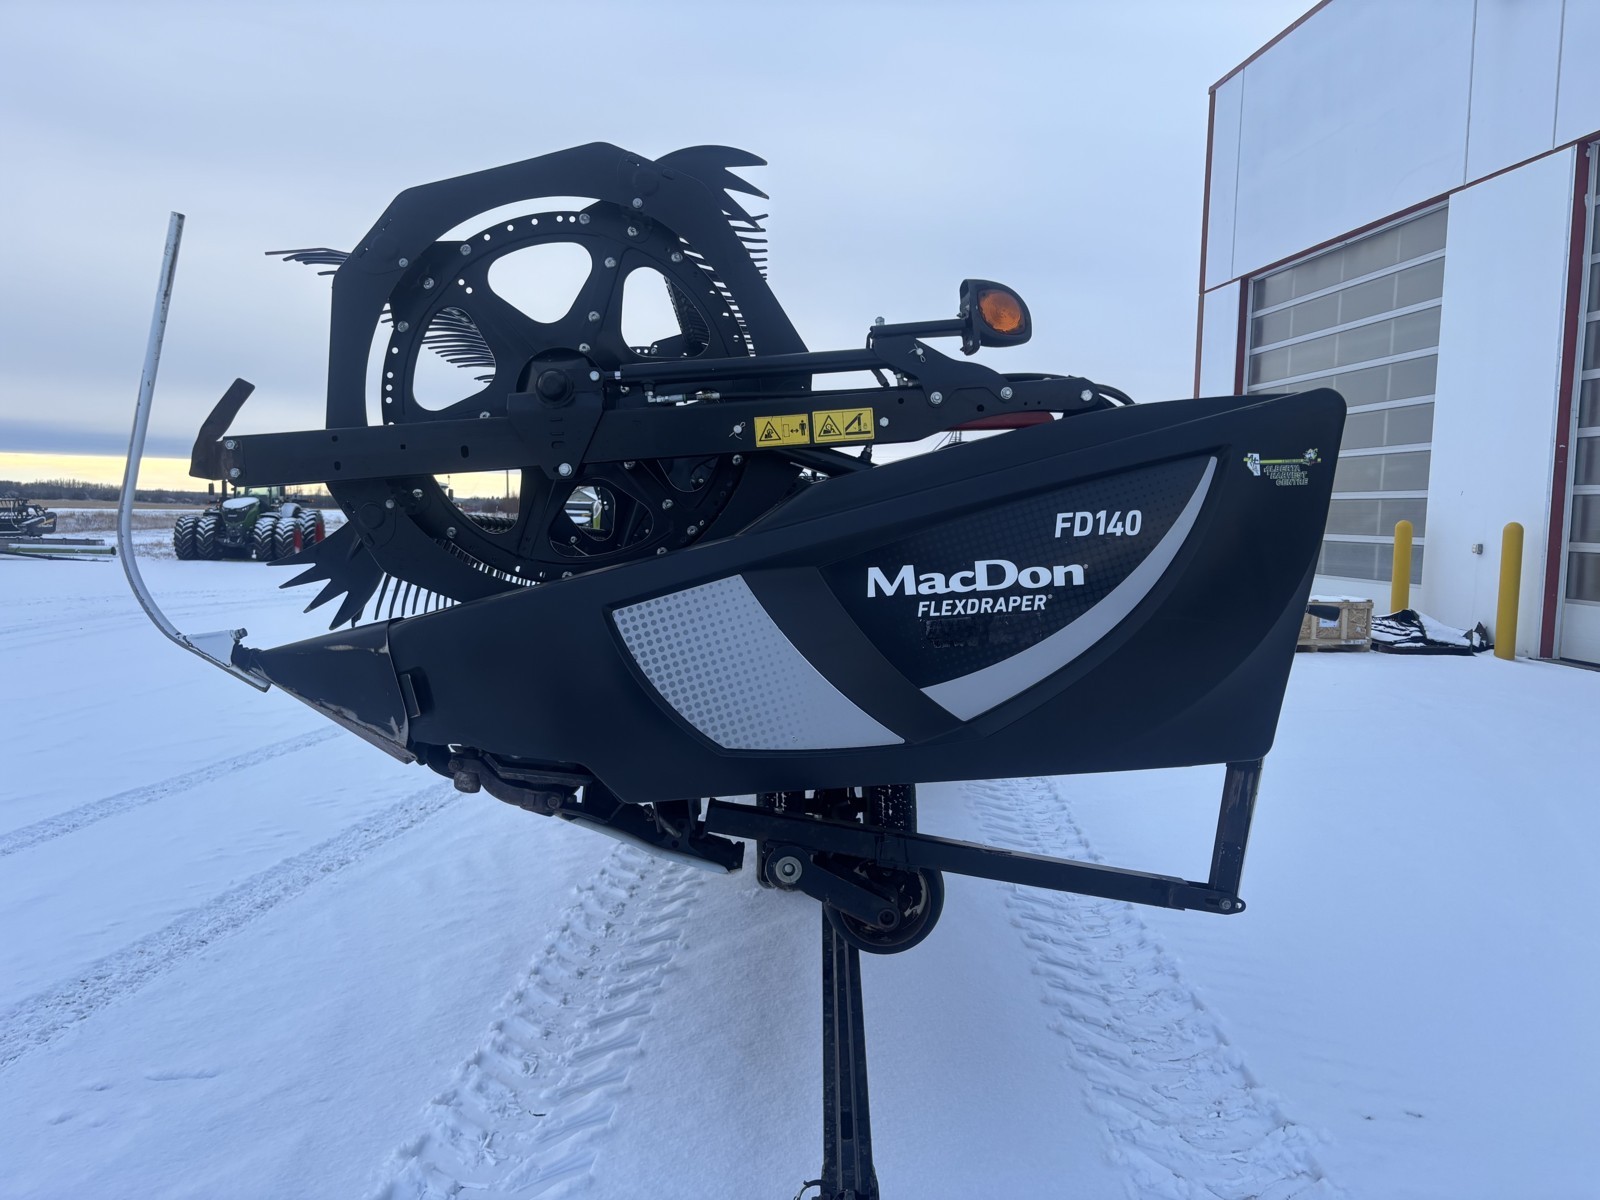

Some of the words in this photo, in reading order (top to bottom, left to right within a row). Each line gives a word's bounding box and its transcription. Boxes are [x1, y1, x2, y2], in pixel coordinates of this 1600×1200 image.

[1263, 464, 1300, 474] ALBERTA
[1270, 470, 1308, 479] HARVEST
[1276, 478, 1308, 486] CENTRE
[1054, 509, 1142, 538] FD140
[867, 559, 1086, 598] MacDon
[917, 594, 1047, 617] FLEXDRAPER
